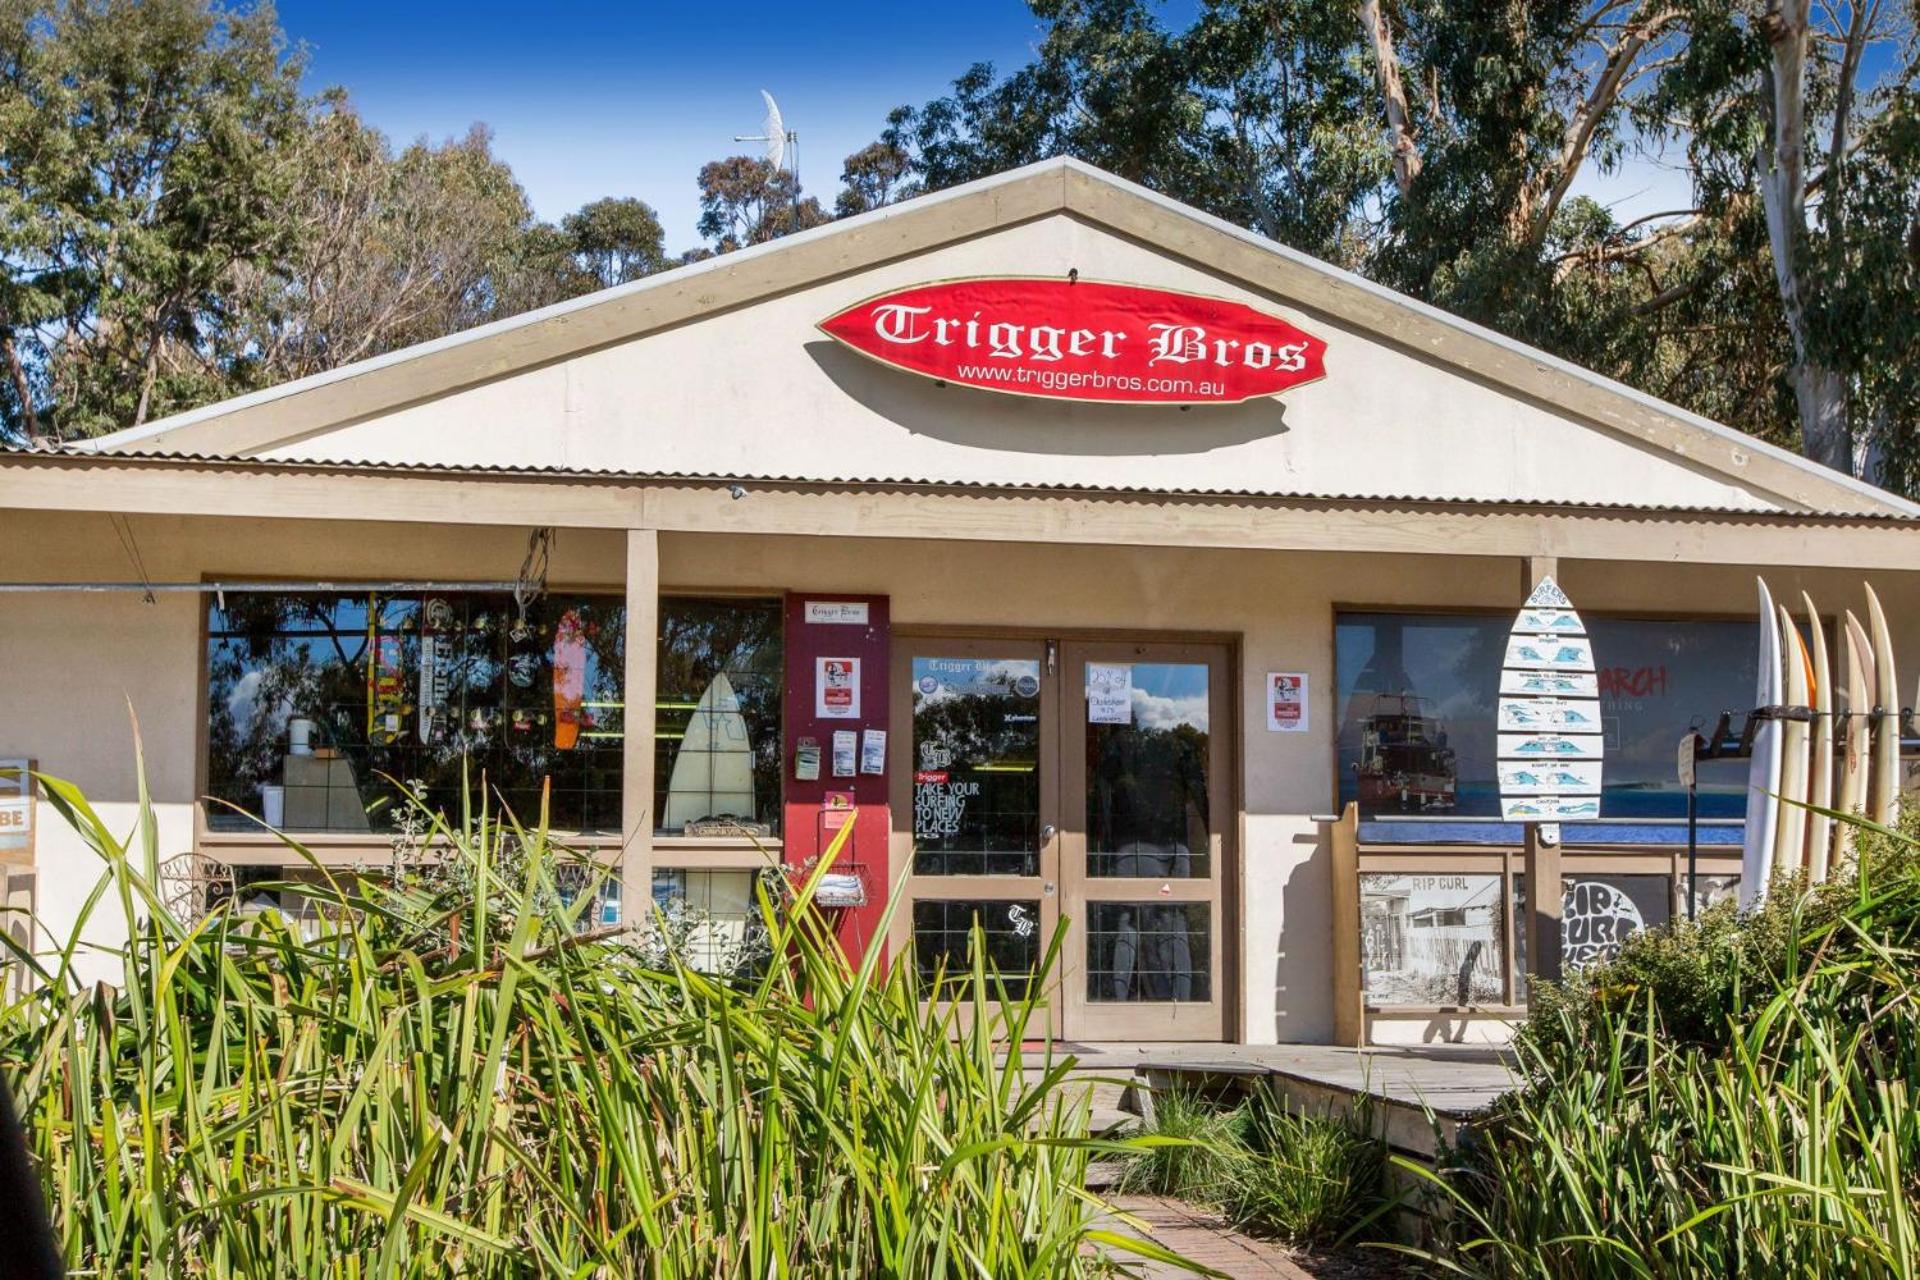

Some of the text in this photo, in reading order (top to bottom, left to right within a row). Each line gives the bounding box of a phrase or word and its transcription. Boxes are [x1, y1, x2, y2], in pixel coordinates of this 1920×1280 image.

[871, 303, 1310, 373] Trigger Bros
[957, 364, 1225, 396] www.triggerbros.com.au
[1530, 583, 1567, 605] SURFERS
[915, 783, 980, 796] TAKE YOUR
[915, 795, 966, 808] SURFING
[915, 806, 965, 821] TO NEW
[916, 820, 960, 833] PLACES
[1412, 877, 1469, 890] RIP CURL
